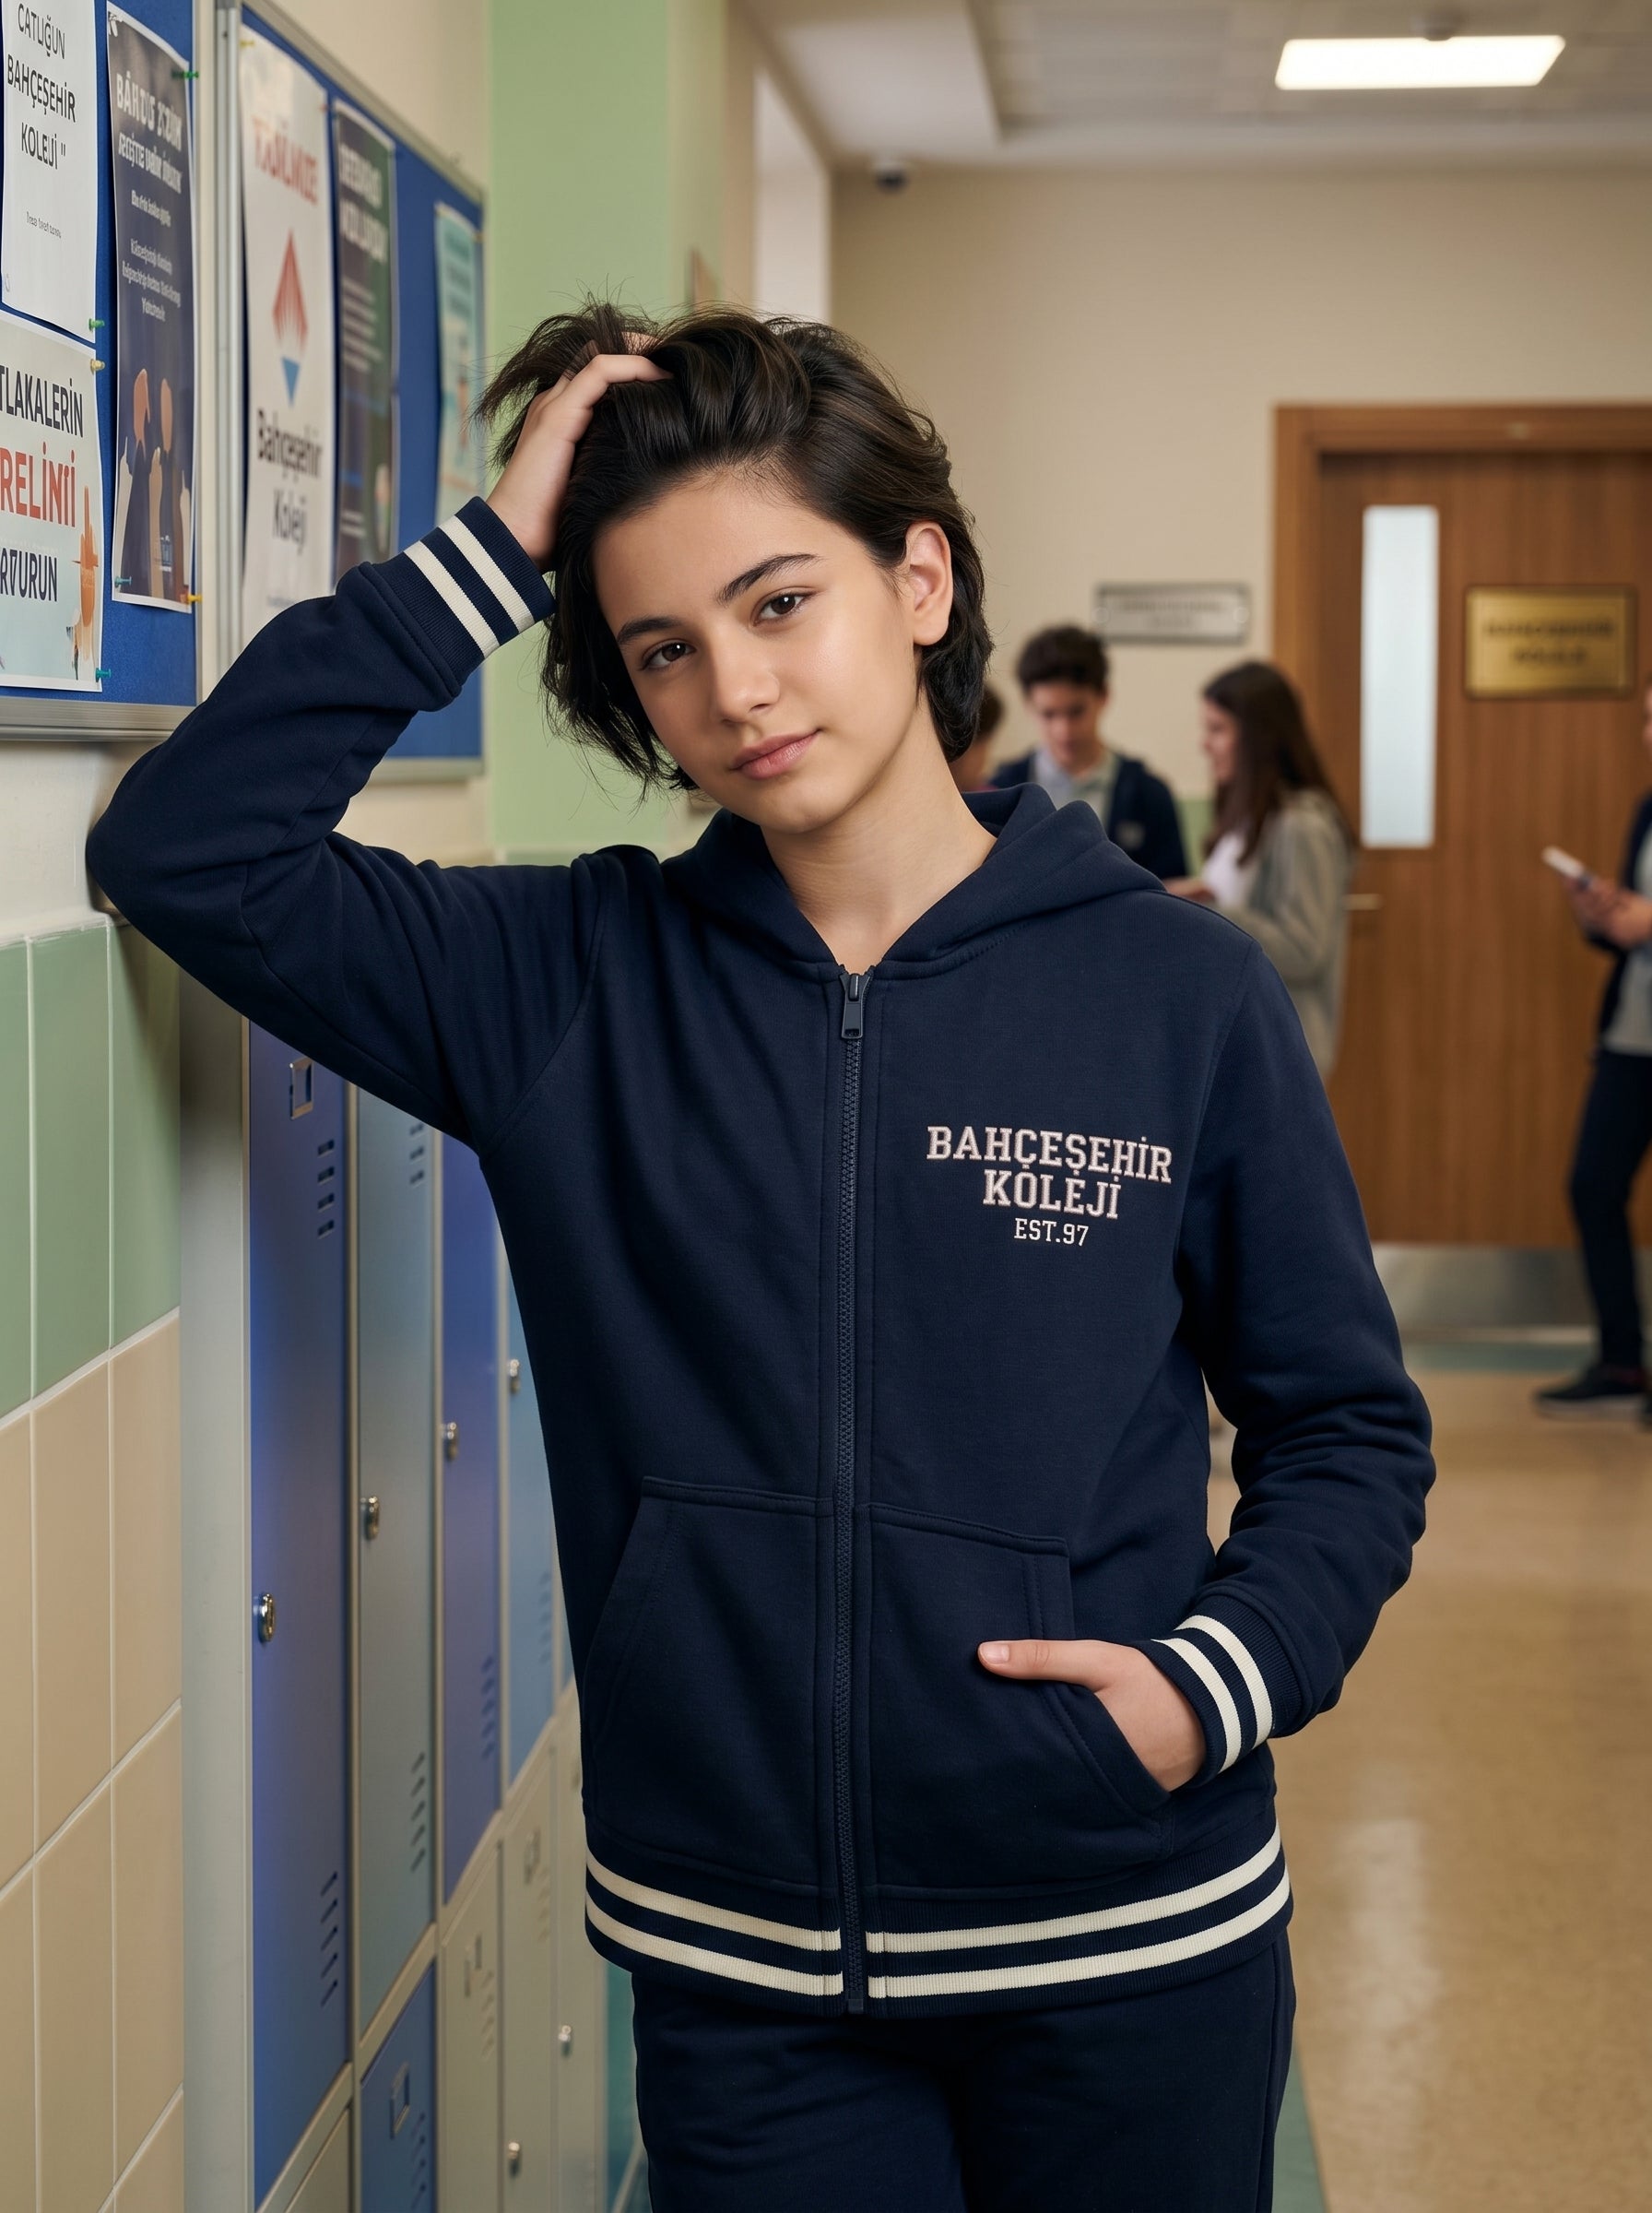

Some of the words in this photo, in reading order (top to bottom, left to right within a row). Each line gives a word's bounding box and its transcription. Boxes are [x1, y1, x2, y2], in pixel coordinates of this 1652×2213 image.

[7, 53, 76, 123] BAHÇEŞEHİR
[926, 1125, 1173, 1185] BAHÇEŞEHİR
[983, 1167, 1121, 1220] KOLEJİ
[1014, 1217, 1089, 1247] EST.97
